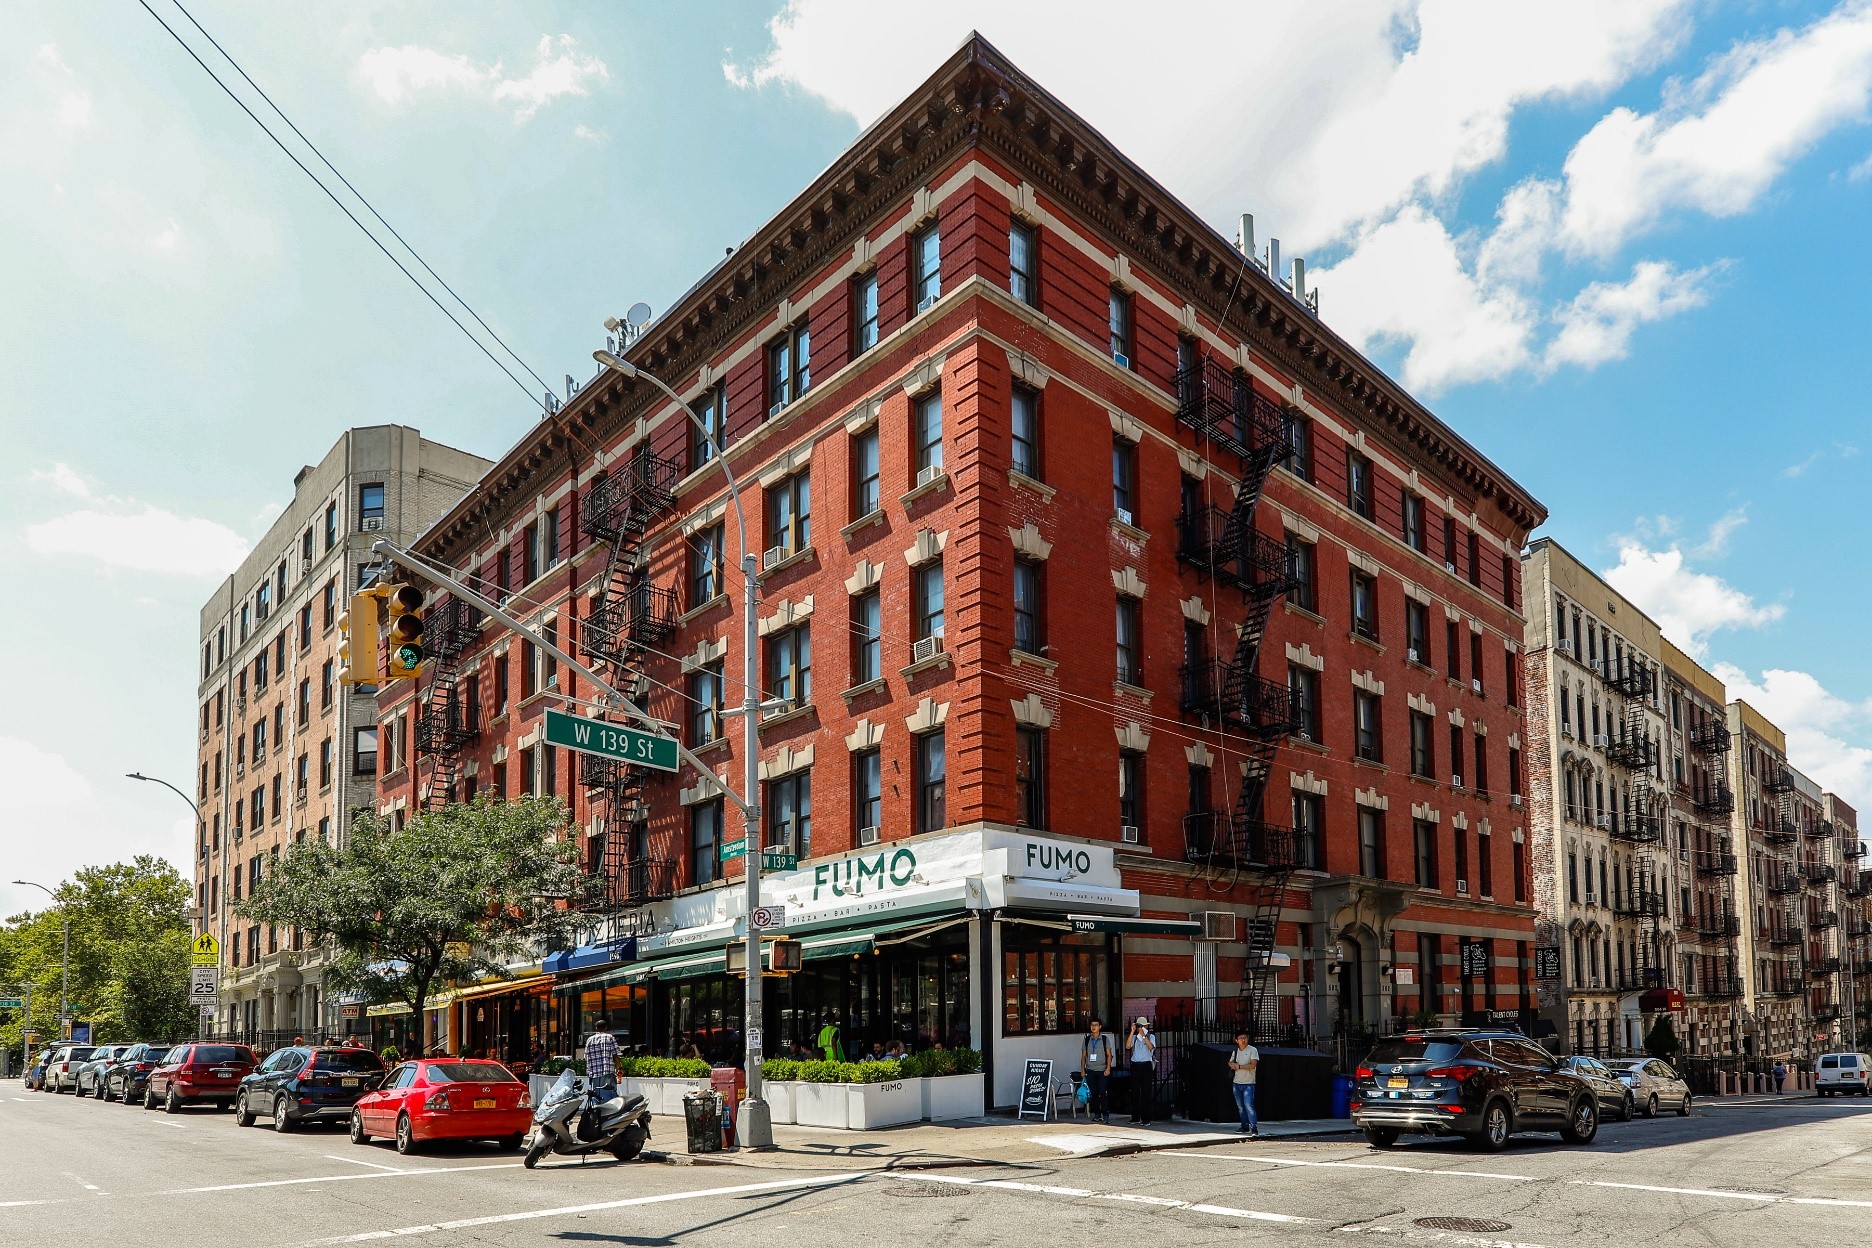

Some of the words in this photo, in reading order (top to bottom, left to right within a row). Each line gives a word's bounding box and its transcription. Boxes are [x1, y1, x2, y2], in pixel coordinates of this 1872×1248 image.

[574, 722, 591, 745] W
[599, 729, 629, 754] 139
[636, 738, 654, 760] St
[723, 841, 745, 854] Amsterdam
[762, 855, 770, 868] W
[773, 856, 786, 869] 139
[1026, 843, 1091, 874] FUMO
[812, 848, 917, 901] FUMO
[792, 914, 818, 924] PIZZA
[834, 908, 851, 917] BAR
[868, 901, 897, 911] PASTA
[1075, 921, 1095, 930] FUMO
[194, 983, 215, 993] 25
[1492, 1011, 1506, 1019] TALENT
[881, 1082, 903, 1093] FUMO
